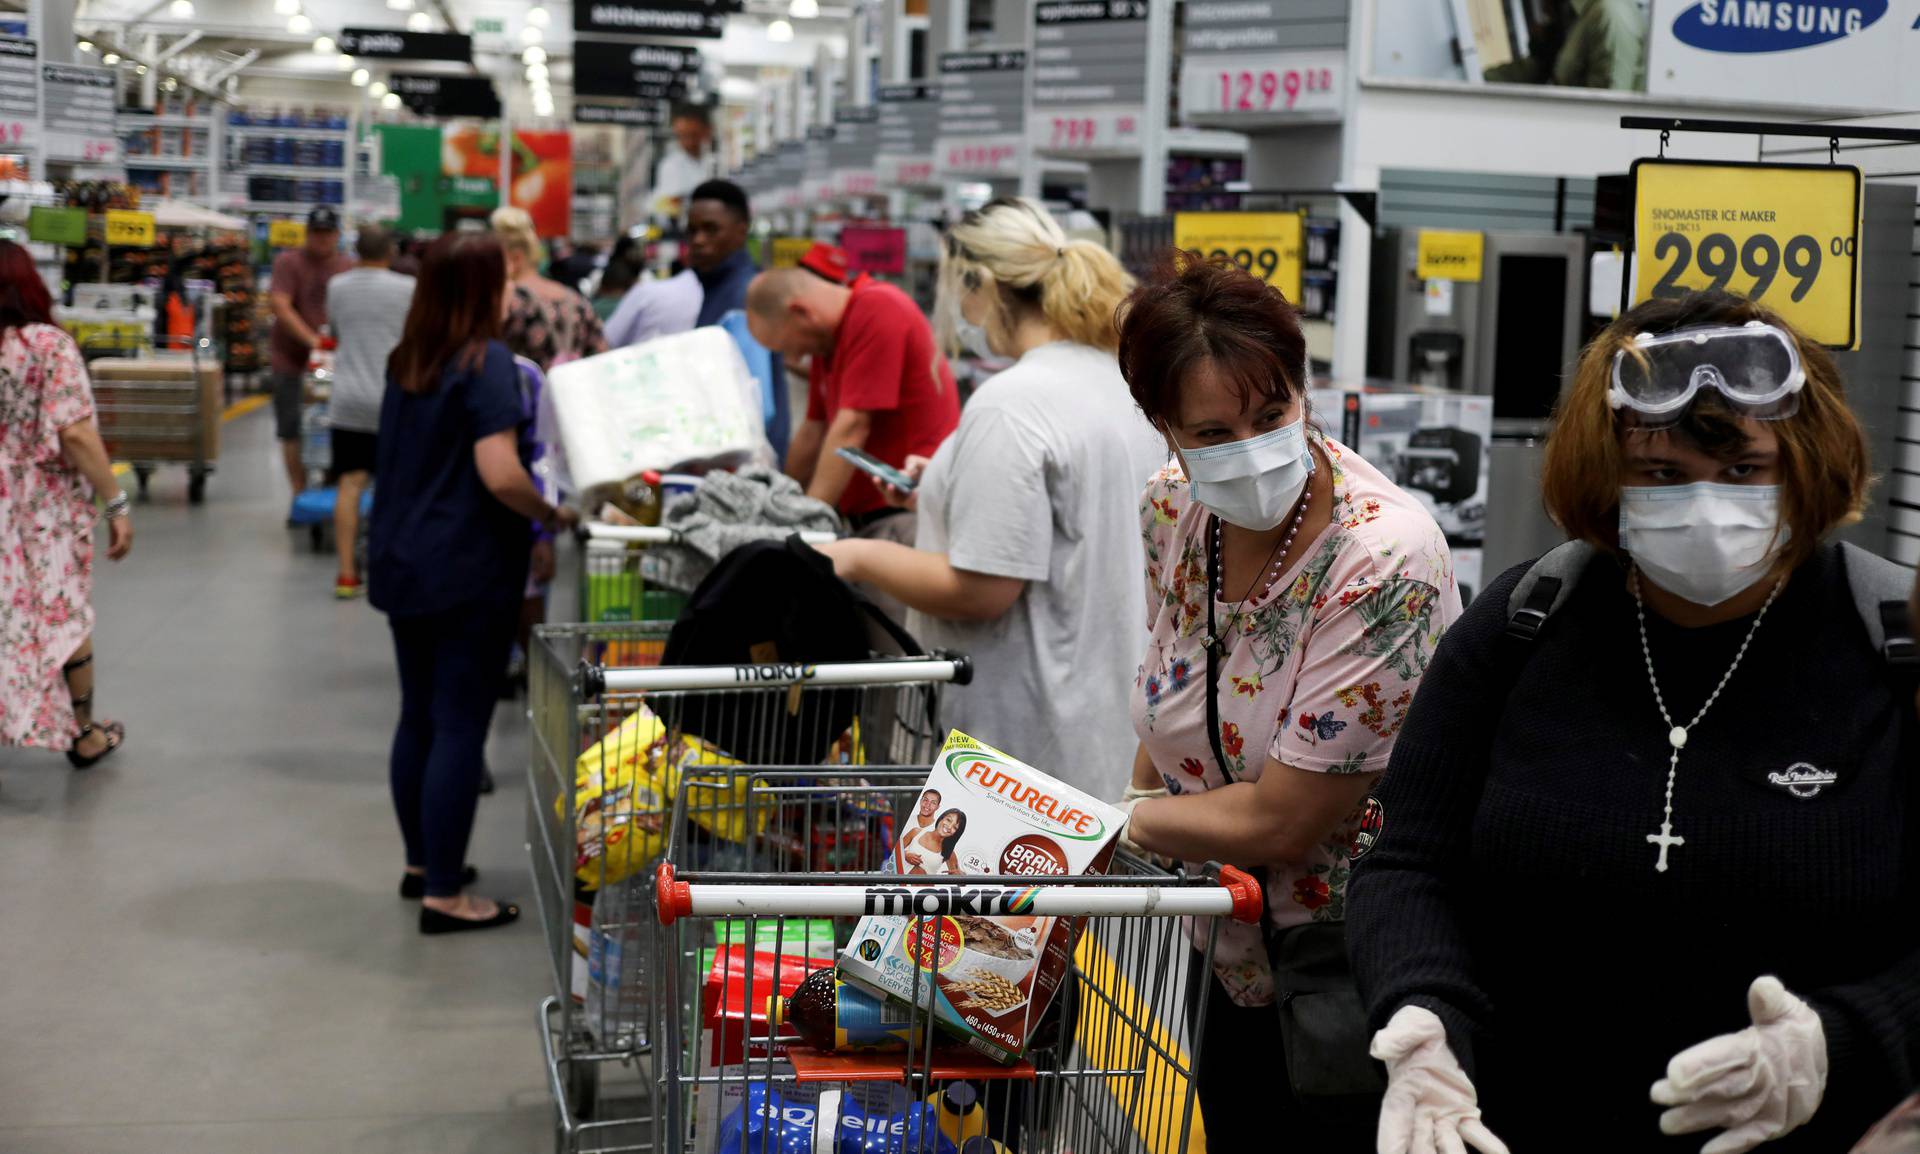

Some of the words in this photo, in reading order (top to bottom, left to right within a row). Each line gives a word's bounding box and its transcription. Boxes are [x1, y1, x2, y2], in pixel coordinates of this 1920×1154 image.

[1700, 0, 1863, 34] SAMSUNG
[1218, 69, 1301, 111] 1299
[1652, 208, 1718, 222] SNOMASTER
[1721, 210, 1738, 222] ICE
[1740, 210, 1777, 223] MAKER
[1651, 232, 1822, 303] 2999
[949, 736, 970, 744] NEW
[968, 856, 980, 867] 38
[865, 886, 1037, 916] makro
[873, 924, 887, 937] 10
[878, 975, 903, 991] EVERY
